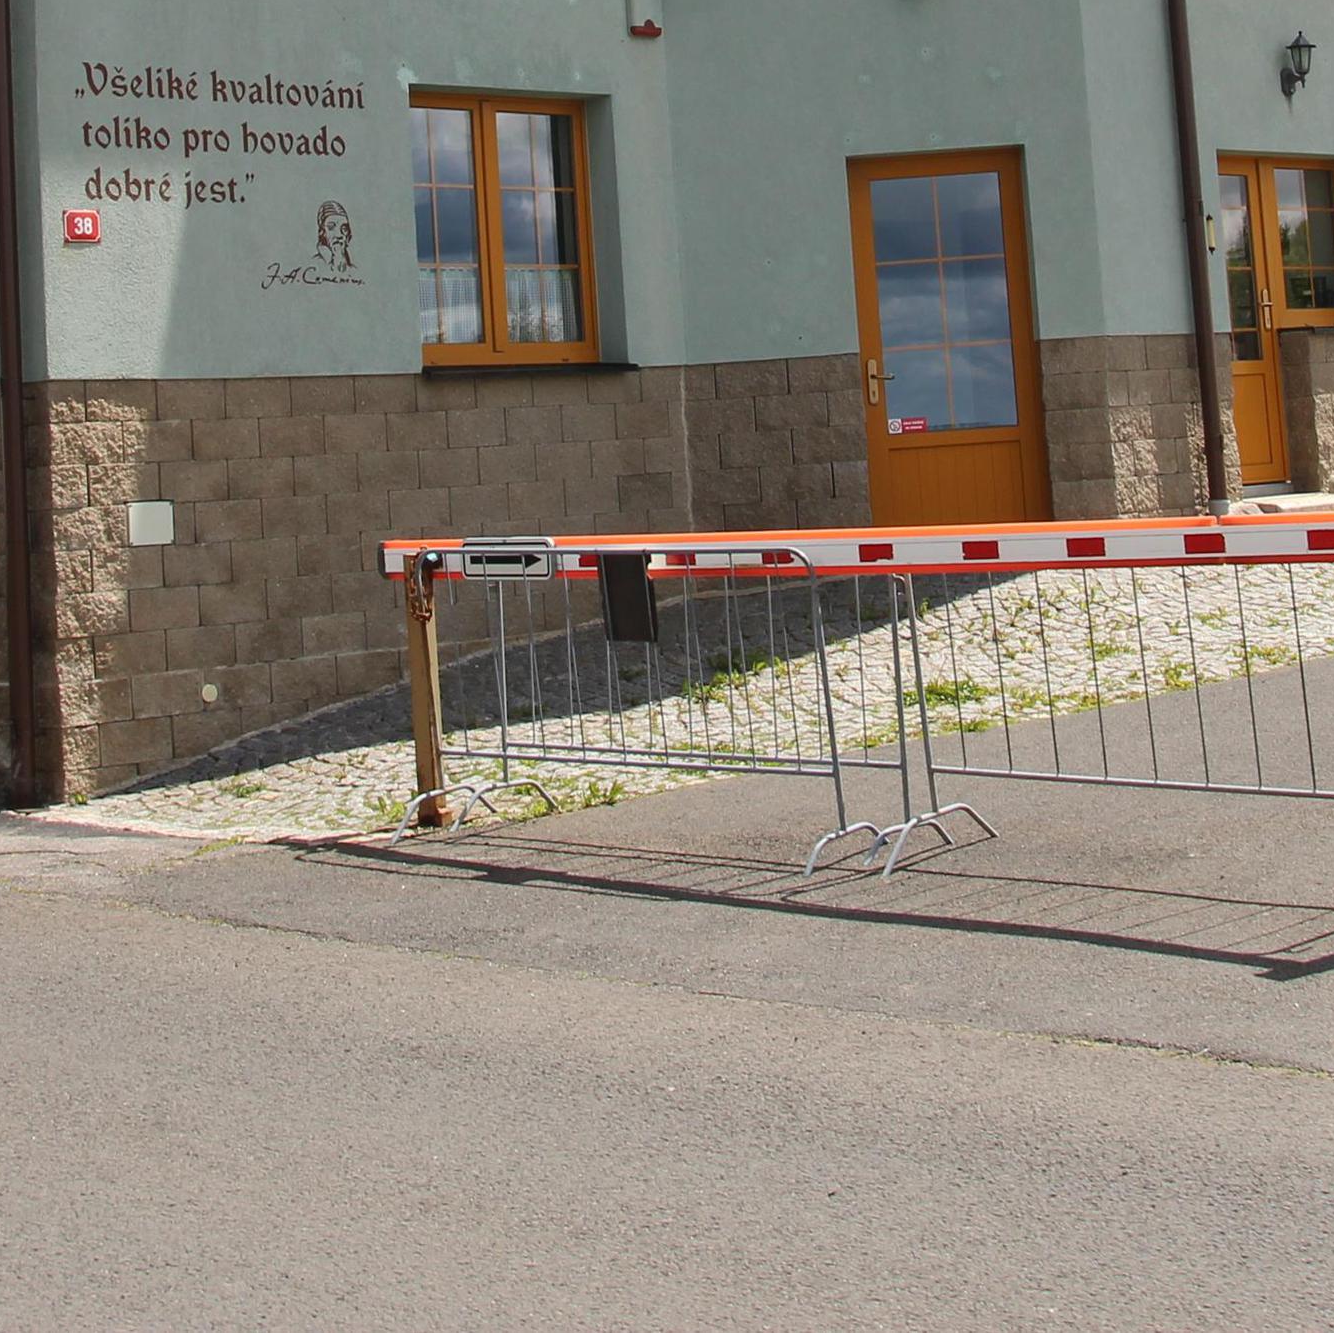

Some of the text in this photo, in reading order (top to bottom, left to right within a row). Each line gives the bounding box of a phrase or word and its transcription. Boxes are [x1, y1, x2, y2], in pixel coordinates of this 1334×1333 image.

[210, 70, 365, 109] kvaltování
[82, 116, 346, 158] toliko pro hovado
[85, 167, 172, 202] dobré
[74, 217, 93, 235] 38
